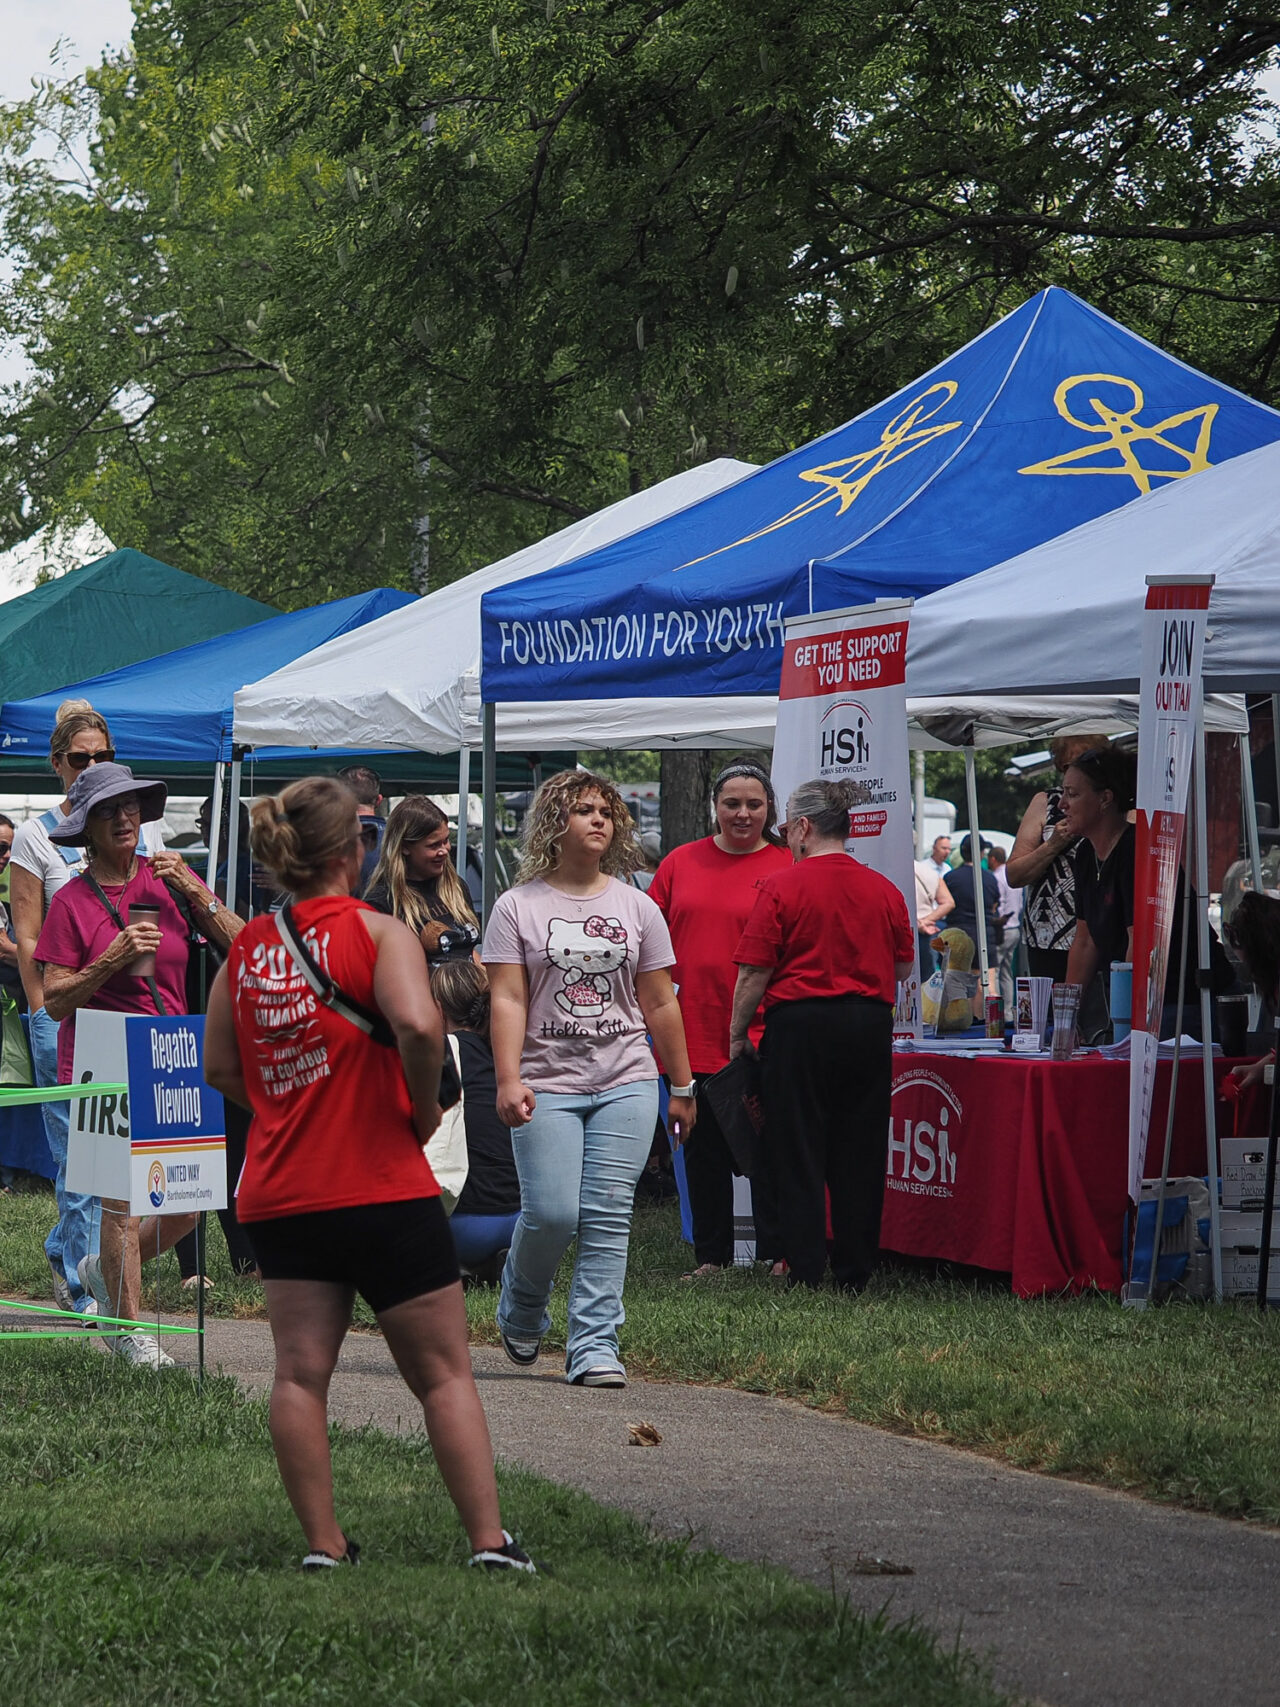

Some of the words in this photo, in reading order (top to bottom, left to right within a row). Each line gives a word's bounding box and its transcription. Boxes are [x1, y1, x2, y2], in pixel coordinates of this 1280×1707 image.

[498, 613, 647, 665] FOUNDATION
[648, 611, 699, 657] FOR
[701, 601, 787, 653] YOUTH
[794, 644, 819, 667] GET
[821, 640, 842, 663] THE
[846, 631, 902, 660] SUPPORT
[1159, 619, 1195, 677] JOIN
[817, 662, 844, 687] YOU
[848, 658, 881, 682] NEED
[835, 765, 863, 774] SERVICES
[859, 778, 884, 790] PEOPLE
[853, 814, 866, 823] AND
[540, 1020, 590, 1037] Hello
[595, 1018, 630, 1037] Kitty
[150, 1027, 199, 1074] Regatta
[152, 1080, 202, 1128] Viewing
[166, 1164, 188, 1183] UNITED
[188, 1163, 201, 1182] WAY
[167, 1186, 196, 1201] Bartholomew
[196, 1184, 213, 1201] County
[886, 1178, 910, 1193] HUMAN
[910, 1182, 948, 1198] SERVICES
